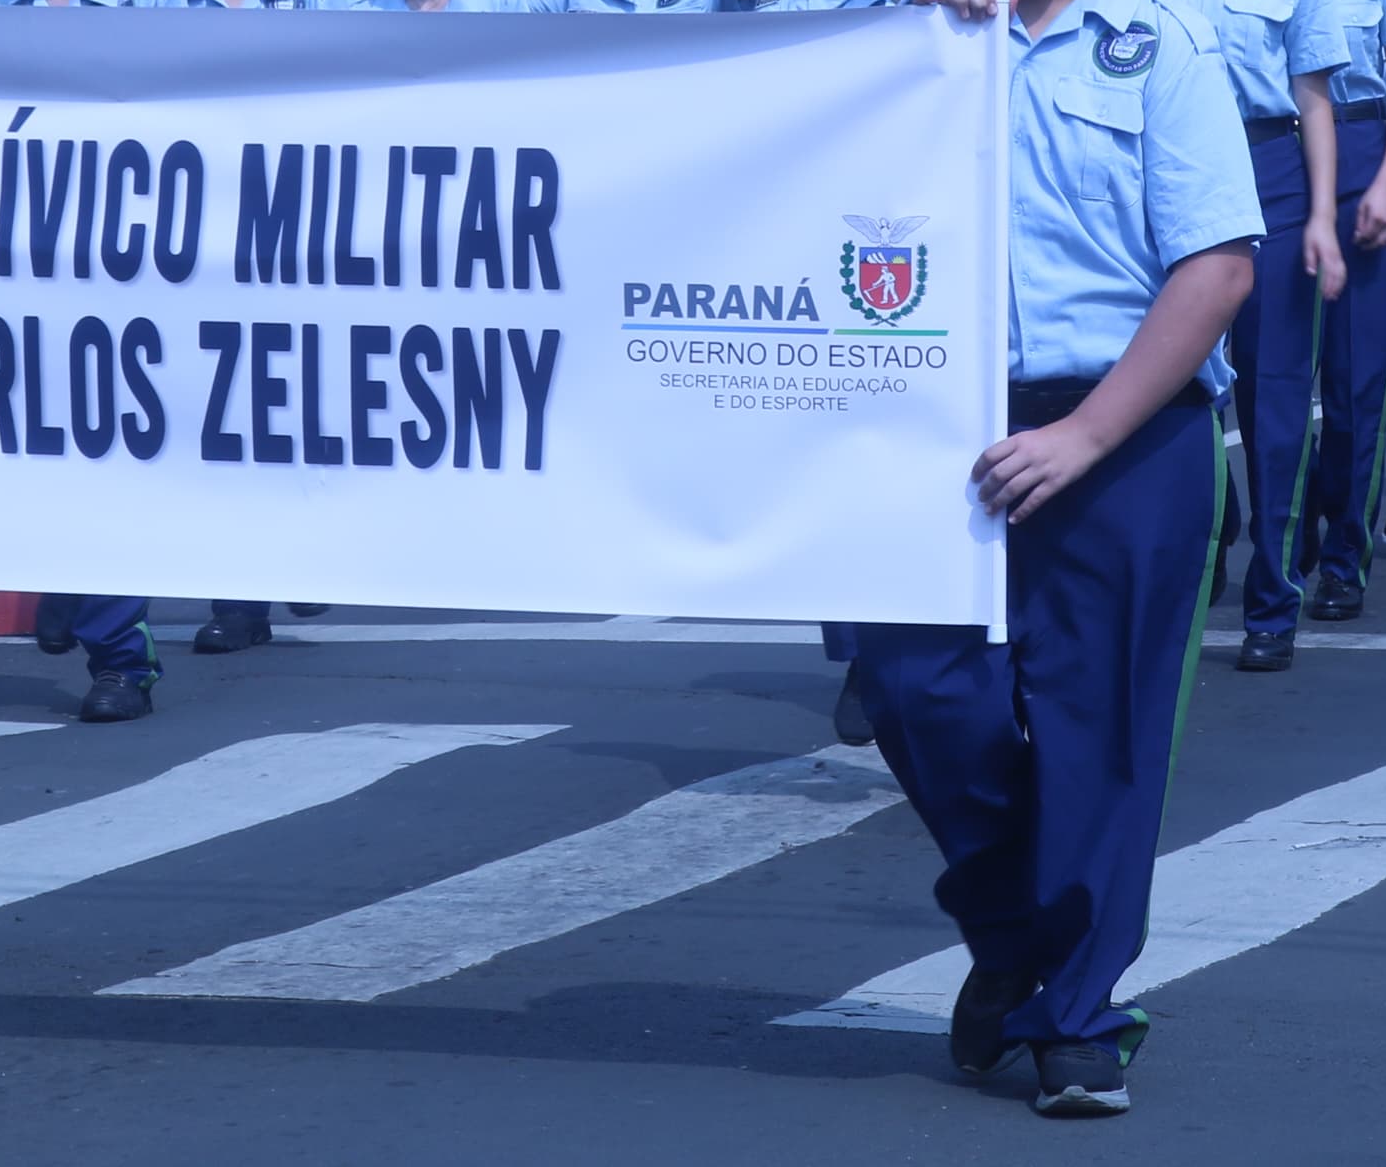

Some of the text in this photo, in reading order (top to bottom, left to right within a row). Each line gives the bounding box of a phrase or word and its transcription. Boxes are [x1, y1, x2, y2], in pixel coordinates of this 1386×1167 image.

[233, 143, 561, 291] MILITAR
[623, 277, 820, 322] PARANÁ
[626, 339, 948, 369] GOVERNO DO ESTADO
[198, 320, 561, 471] ZELESNY
[659, 373, 907, 396] SECRETARIA DA EDUCAÇÃO
[713, 394, 849, 412] E DO ESPORTE
